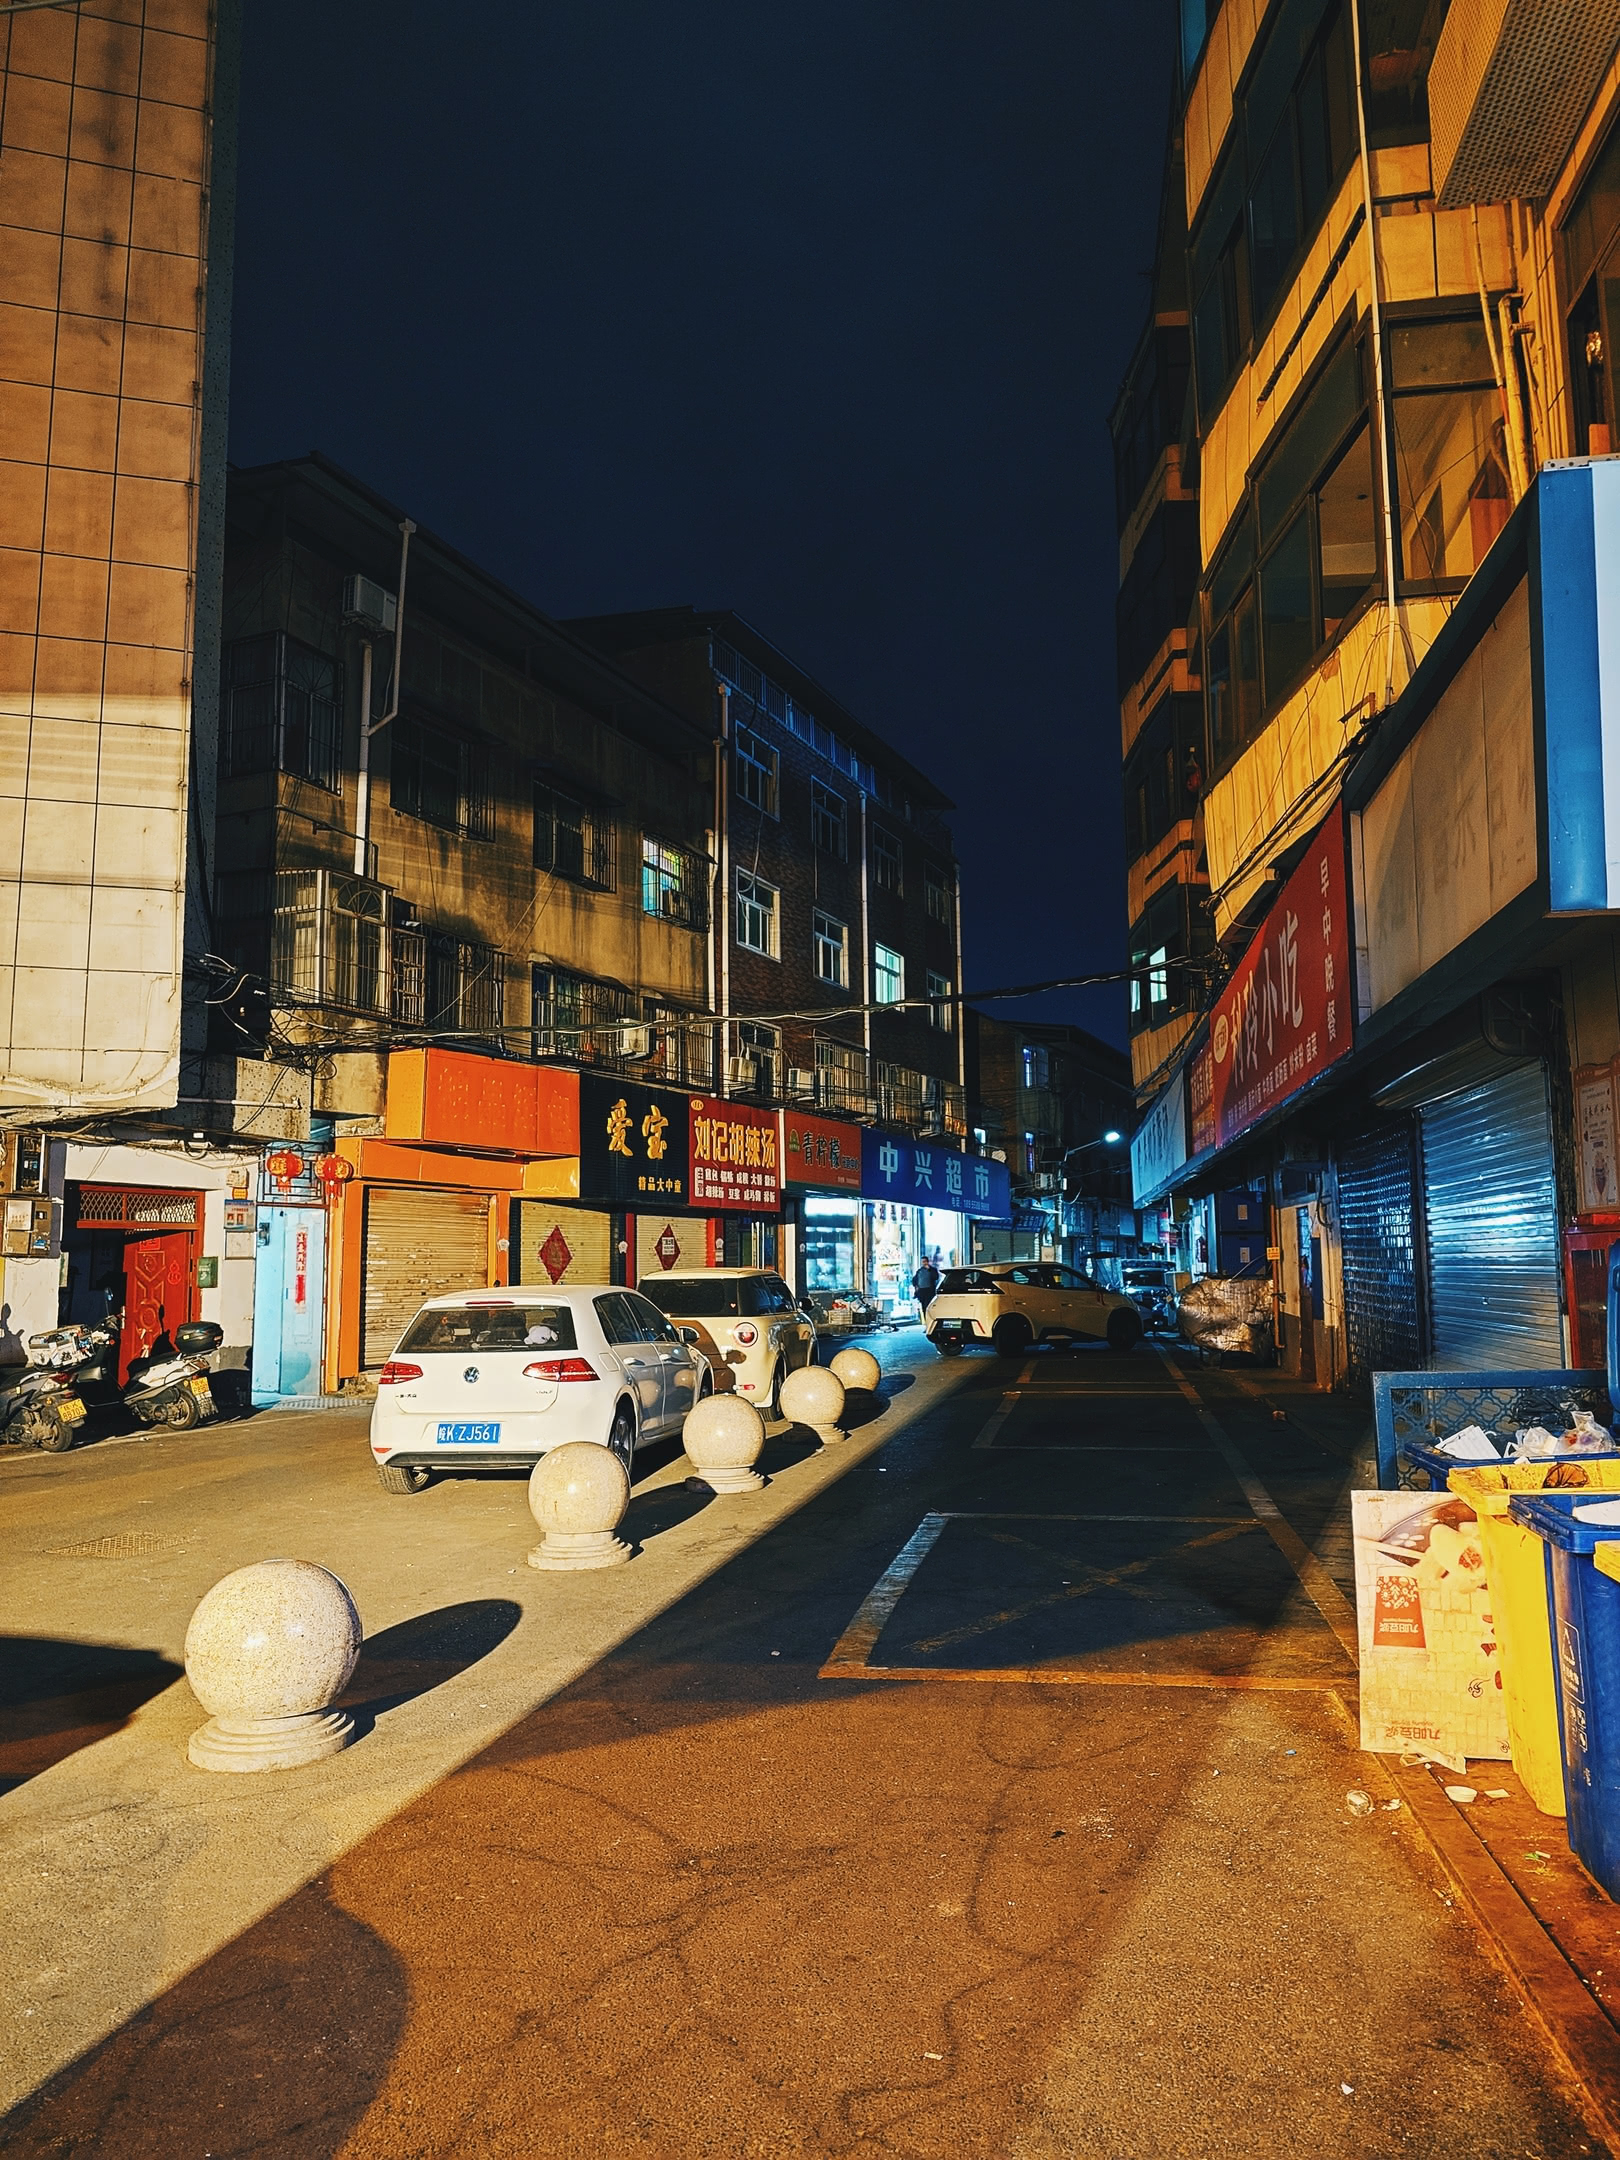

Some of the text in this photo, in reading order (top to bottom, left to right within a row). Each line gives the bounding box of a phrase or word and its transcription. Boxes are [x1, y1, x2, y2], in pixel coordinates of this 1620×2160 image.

[1319, 855, 1337, 1042] 早中晚餐
[606, 1098, 669, 1161] 爱宝
[694, 1115, 776, 1169] 刘记胡辣汤
[879, 1140, 990, 1201] 中兴超市
